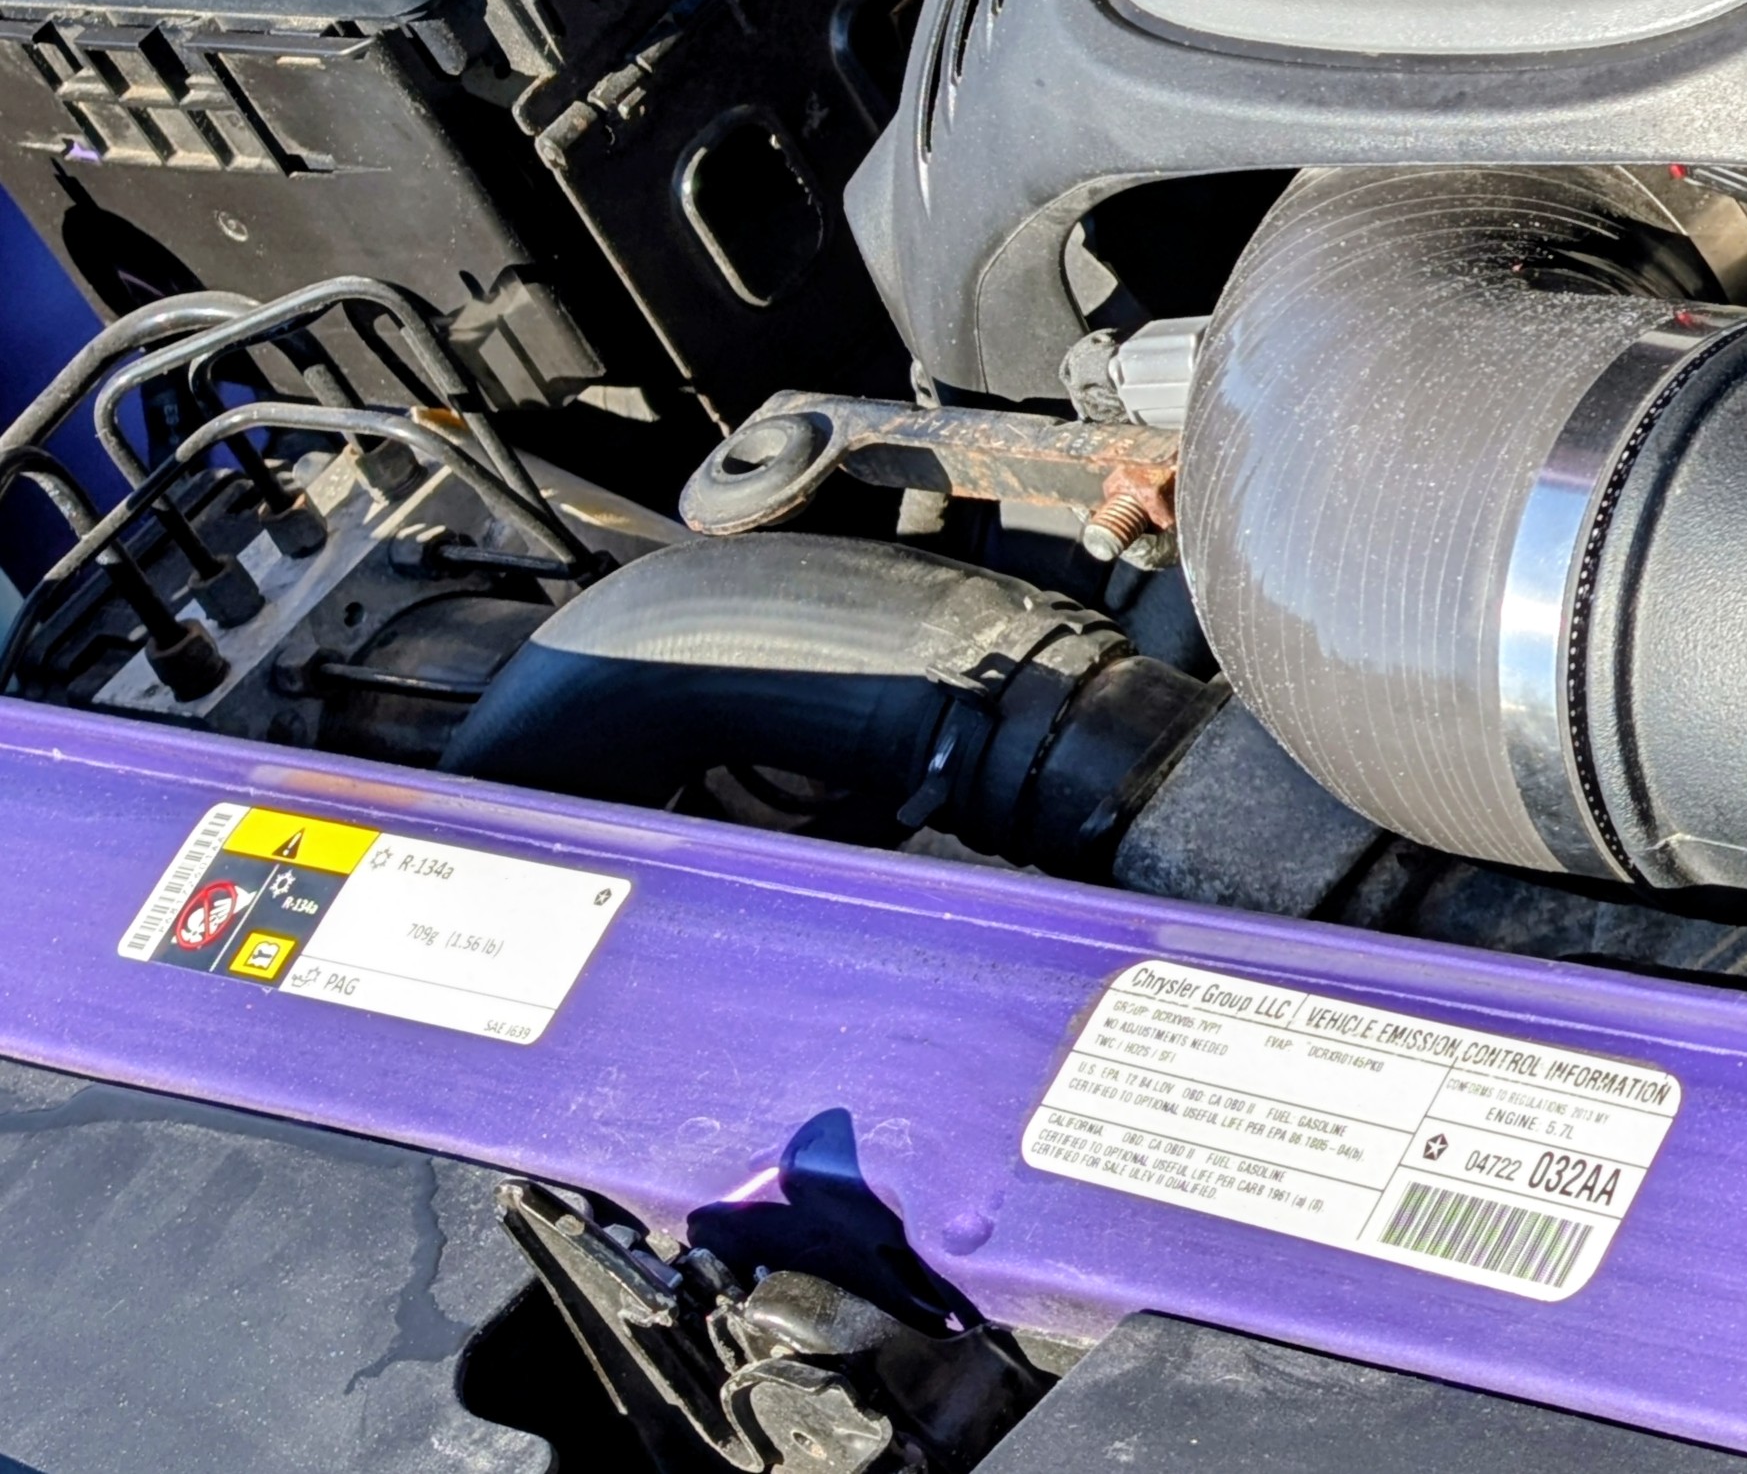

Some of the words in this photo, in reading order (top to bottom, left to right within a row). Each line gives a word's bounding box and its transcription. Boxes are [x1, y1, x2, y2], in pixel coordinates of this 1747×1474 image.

[397, 854, 455, 881] R-134a
[281, 896, 320, 916] R-134a
[406, 923, 440, 946] 709g
[445, 930, 481, 953] (1.56
[481, 937, 504, 959] lb)
[324, 973, 361, 997] PAG
[1132, 967, 1202, 998] Chrysler
[1201, 983, 1254, 1014] Group
[1254, 995, 1292, 1020] LLC
[484, 1019, 506, 1035] SAE
[1095, 1034, 1117, 1049] TWC
[1103, 1017, 1119, 1029] NO
[1120, 1021, 1190, 1047] ADJUSTMENTS
[1190, 1037, 1229, 1057] NEEDED
[1306, 1005, 1378, 1039] VEHICLE
[1376, 1022, 1463, 1059] EMISSION
[1461, 1041, 1542, 1078] CONTROL
[1544, 1059, 1672, 1106] INFORMATION
[1068, 1077, 1119, 1099] CERTIFIED
[1119, 1090, 1134, 1103] TO
[1133, 1093, 1180, 1115] OPTIONAL
[1182, 1106, 1218, 1125] USEFUL
[1220, 1114, 1247, 1131] LIFE
[1245, 1121, 1268, 1135] PER
[1266, 1127, 1288, 1142] EPA
[1208, 1093, 1222, 1107] CA
[1223, 1097, 1246, 1111] OBD
[1297, 1115, 1349, 1137] GASOLINE
[1445, 1077, 1493, 1098] CONFORMS
[1495, 1087, 1507, 1102] TO
[1507, 1091, 1569, 1115] REGULATIONS
[1593, 1111, 1612, 1125] MY
[1545, 1120, 1575, 1141] 5.7L
[1030, 1141, 1081, 1164] CERTIFIED
[1080, 1154, 1101, 1169] FOR
[1102, 1159, 1128, 1177] SALE
[1128, 1167, 1156, 1185] ULEV
[1038, 1128, 1088, 1150] CERTIFIED
[1089, 1141, 1103, 1154] TO
[1103, 1145, 1150, 1167] OPTIONAL
[1152, 1158, 1188, 1177] USEFUL
[1190, 1167, 1214, 1183] LIFE
[1215, 1174, 1236, 1189] PER
[1236, 1179, 1267, 1196] CARB
[1267, 1187, 1292, 1204] 1961
[1147, 1138, 1162, 1151] CA
[1163, 1142, 1186, 1158] OBD
[1236, 1160, 1288, 1183] GASOLINE
[1464, 1150, 1523, 1182] 04722
[1527, 1151, 1622, 1206] 032AA
